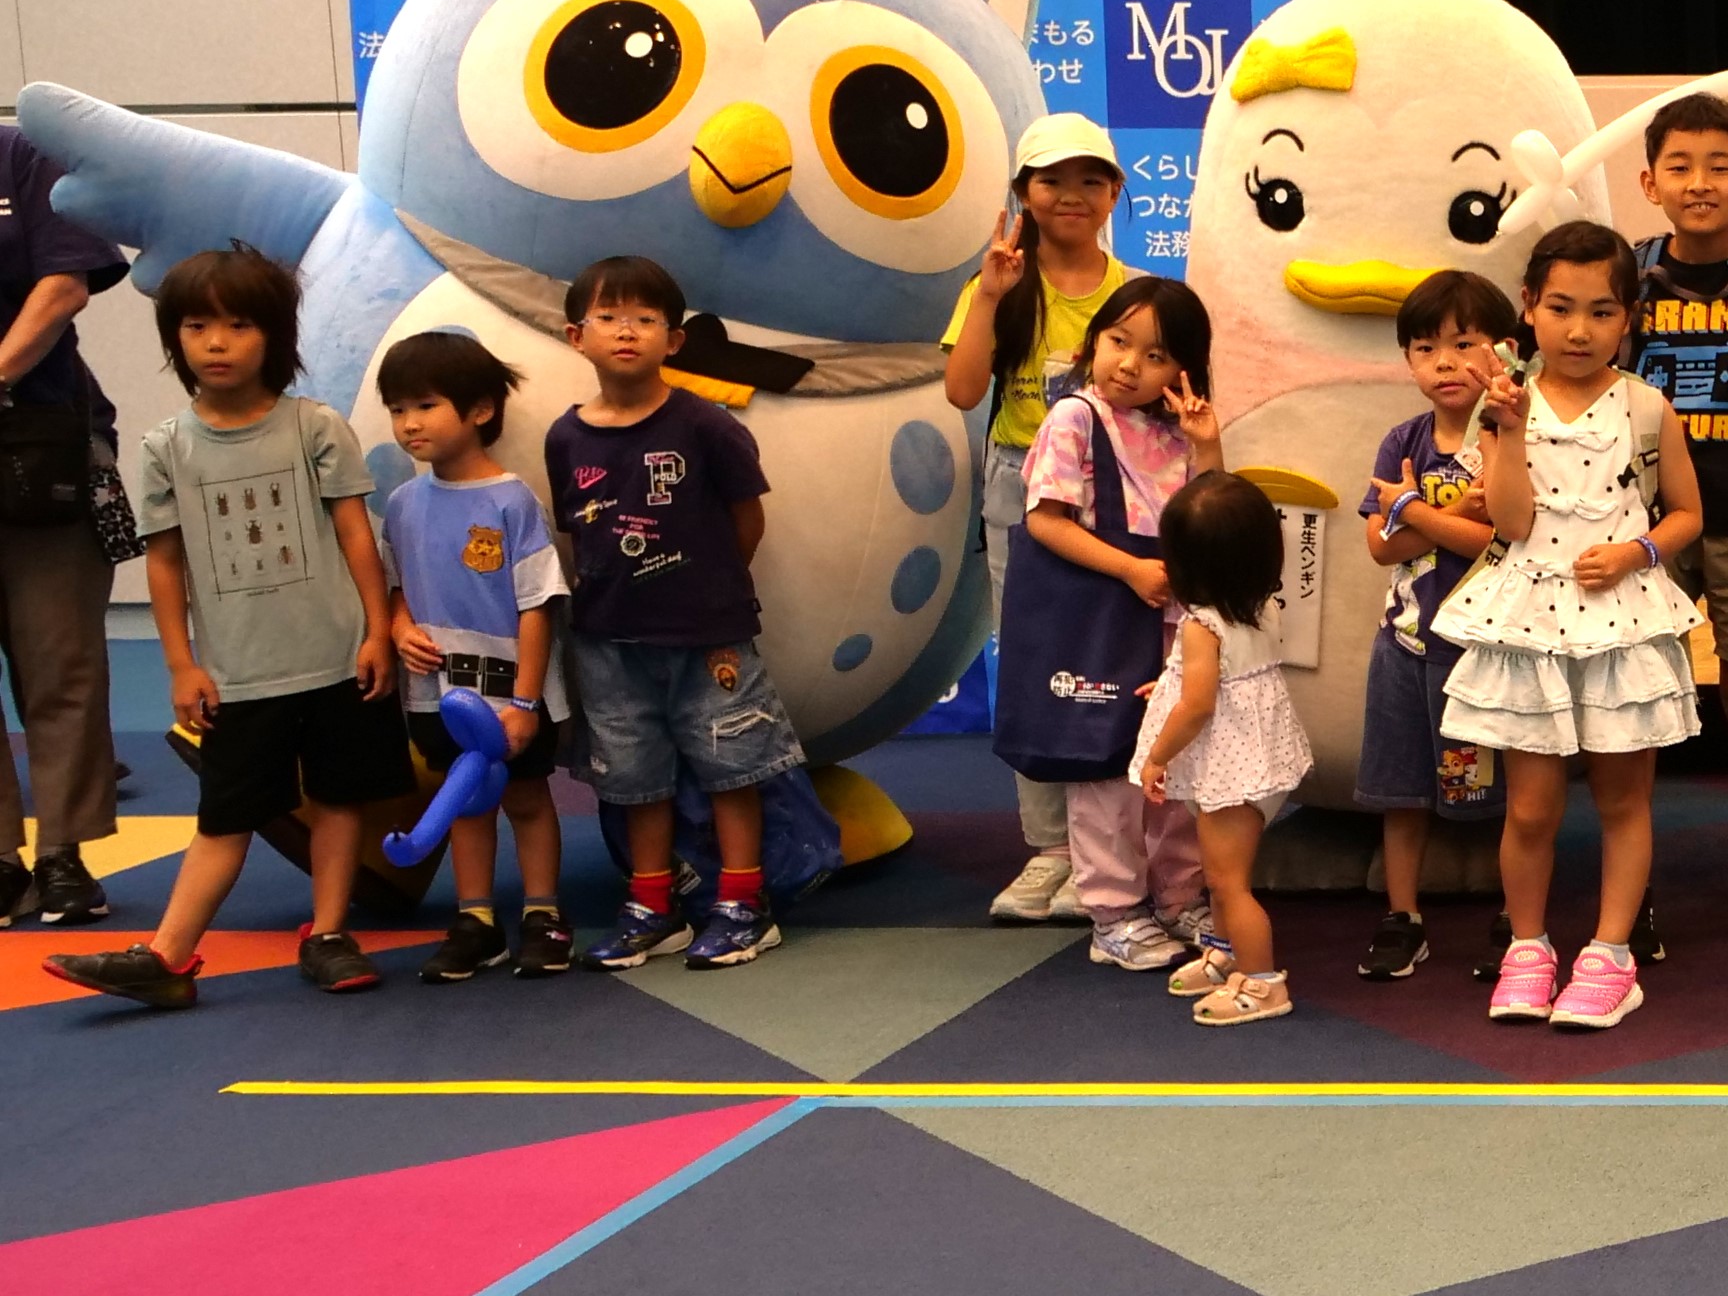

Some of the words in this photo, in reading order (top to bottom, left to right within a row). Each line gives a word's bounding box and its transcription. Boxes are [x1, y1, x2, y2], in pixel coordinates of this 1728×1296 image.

[1300, 513, 1318, 599] 更生ペンギン
